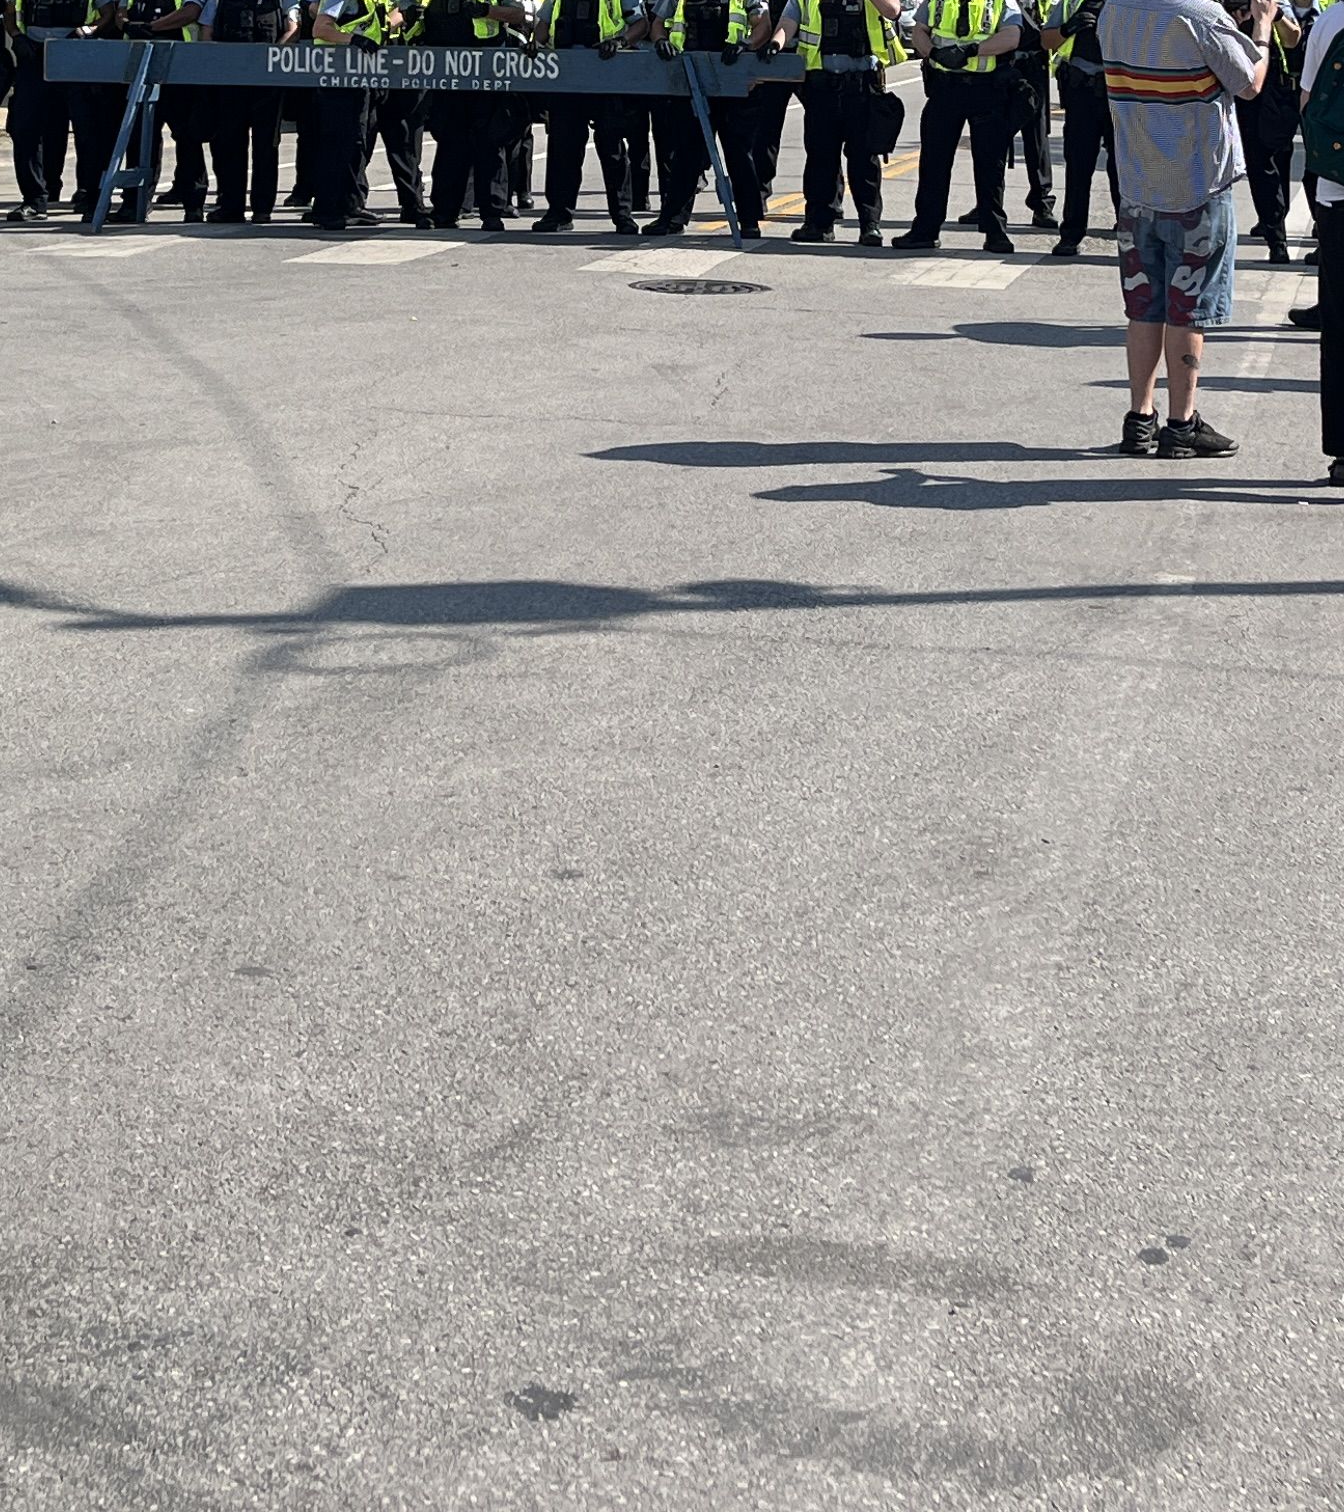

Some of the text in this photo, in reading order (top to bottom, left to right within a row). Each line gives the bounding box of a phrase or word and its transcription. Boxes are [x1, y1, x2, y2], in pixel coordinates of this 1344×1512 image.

[267, 47, 336, 73] POLICE
[445, 50, 483, 76] NOT
[492, 51, 560, 79] CROSS
[320, 76, 511, 91] CHICAGO POLICE DEPT
